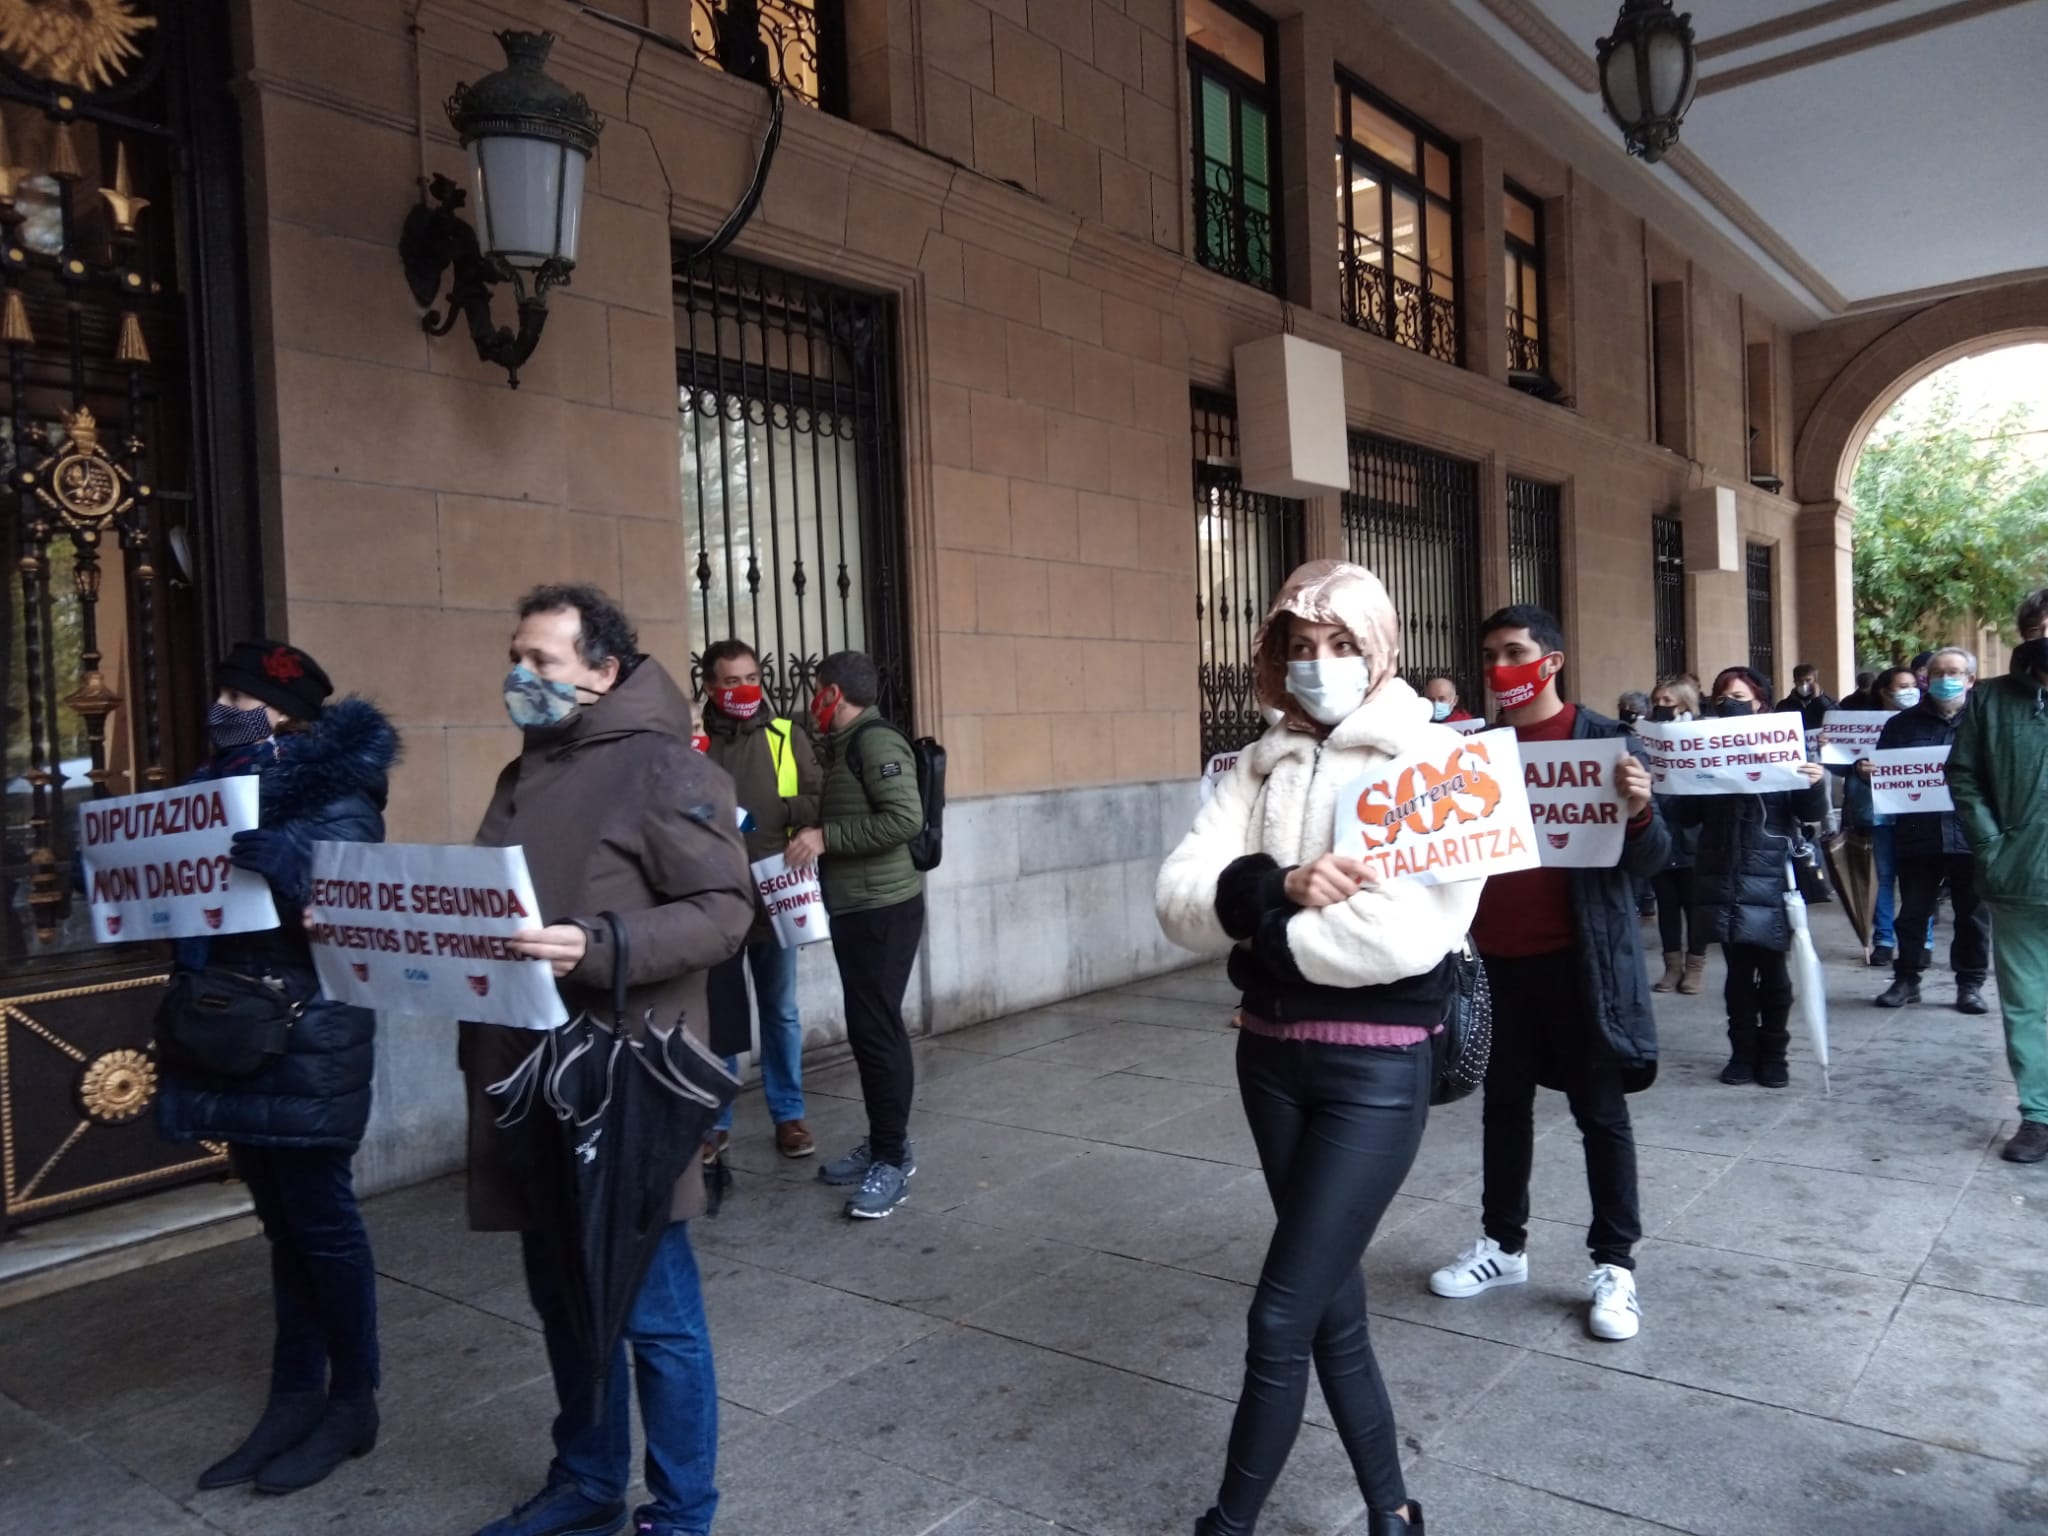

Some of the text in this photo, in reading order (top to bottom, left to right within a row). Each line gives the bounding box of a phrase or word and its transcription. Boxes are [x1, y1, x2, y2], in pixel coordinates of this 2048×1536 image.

[1680, 738, 1704, 751] DE
[1709, 729, 1799, 749] SEGUNDA
[1701, 757, 1721, 768] DE
[1726, 750, 1802, 766] PRIMERA
[1525, 761, 1603, 789] AJAR
[1874, 780, 1914, 790] DENOK
[1357, 741, 1501, 850] SOS
[85, 791, 229, 847] DIPUTAZIOA
[1530, 803, 1619, 825] PAGAR
[93, 854, 231, 905] NON DAGO?
[312, 879, 529, 918] ECTOR DE SEGUNDA
[404, 930, 433, 955] DE
